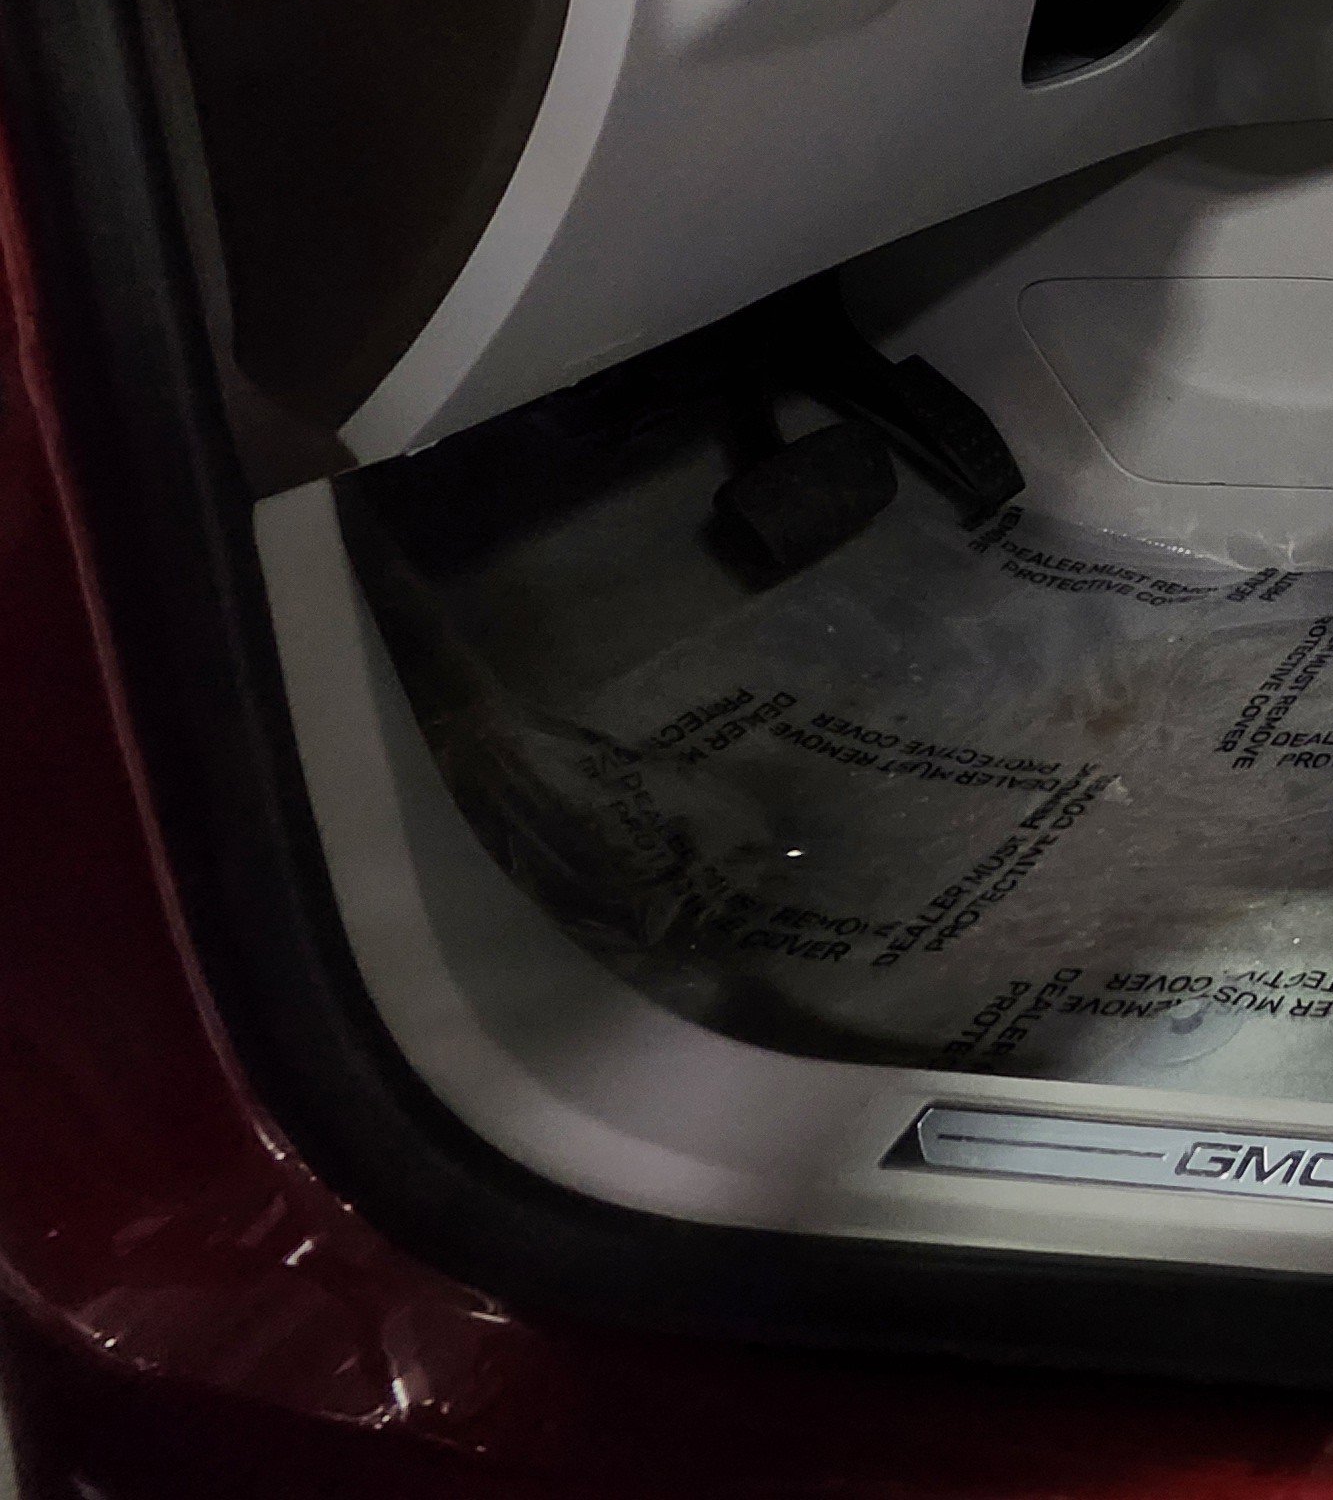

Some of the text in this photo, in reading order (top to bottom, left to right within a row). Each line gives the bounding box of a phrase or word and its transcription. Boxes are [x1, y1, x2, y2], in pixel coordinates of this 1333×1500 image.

[1001, 560, 1137, 595] PROTECTIVE
[1002, 539, 1090, 575] DEALER
[1087, 561, 1149, 585] MUST
[768, 721, 880, 767] REMOVE
[811, 712, 899, 749] COVER
[923, 834, 1061, 953] PROTECTIVE
[871, 884, 971, 968] DEALER
[1103, 972, 1214, 994] COVER
